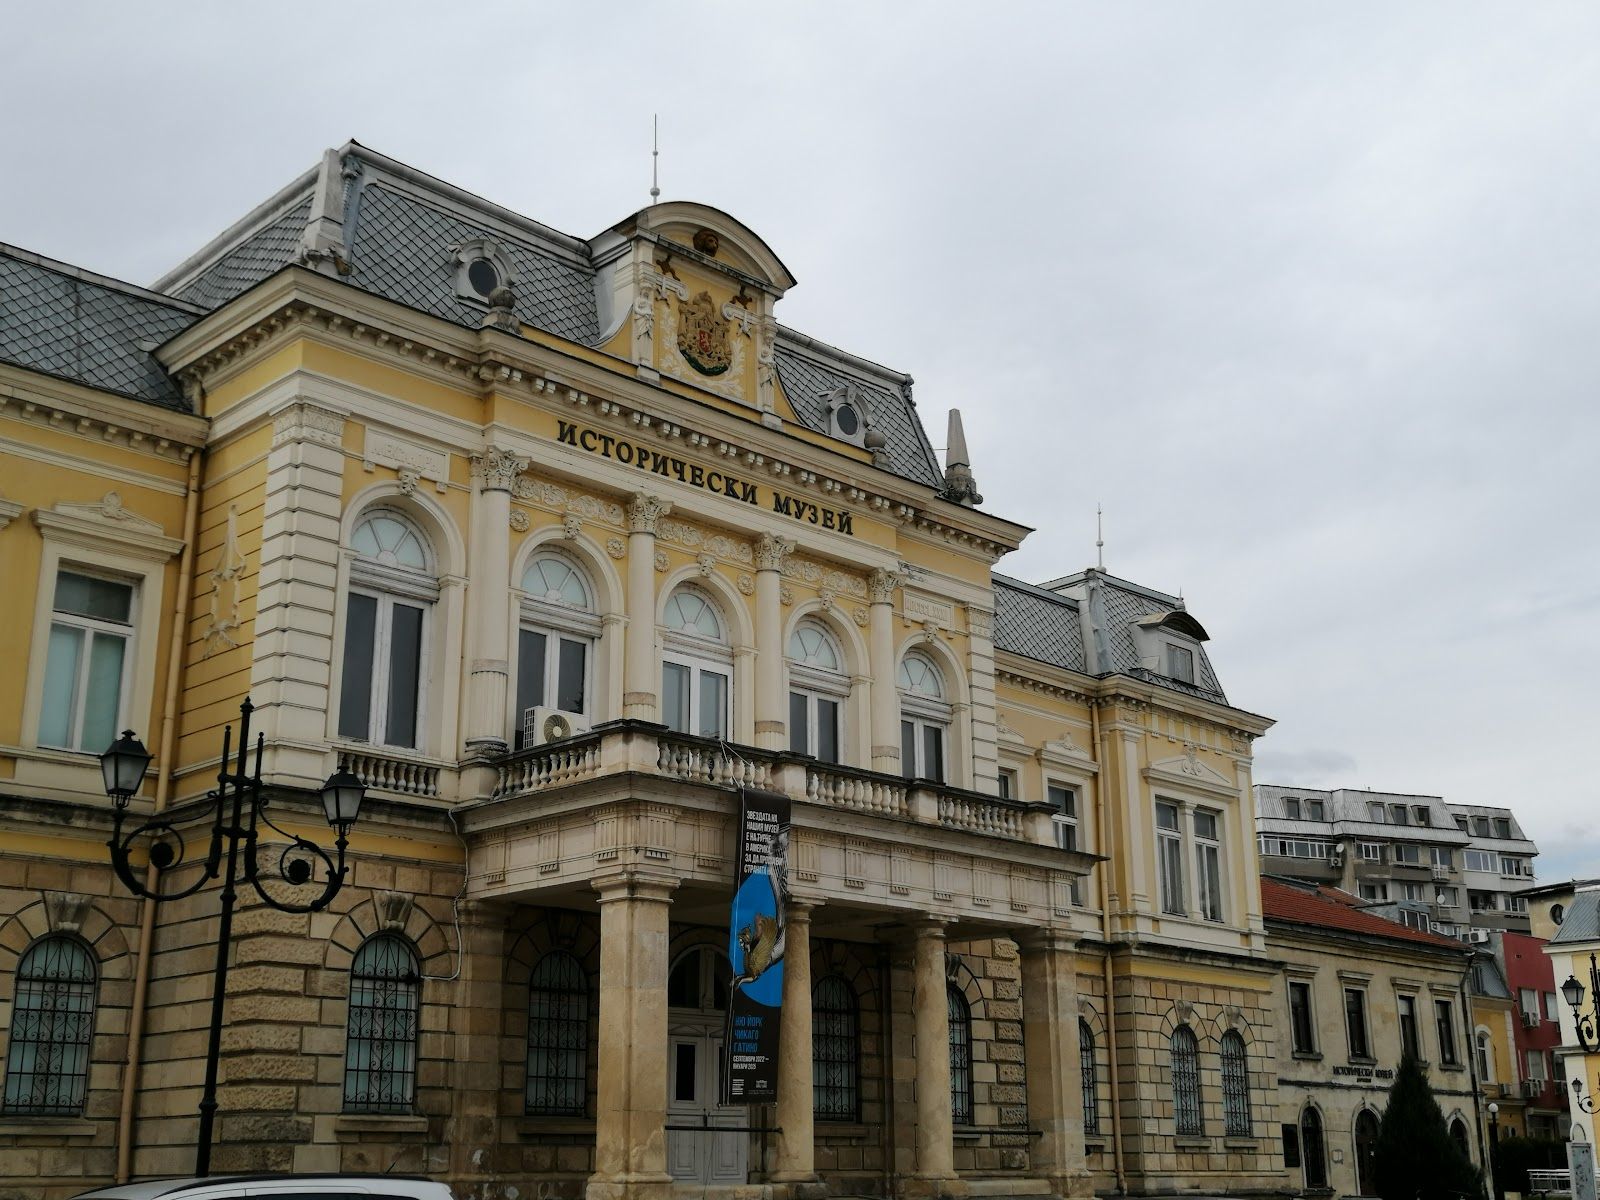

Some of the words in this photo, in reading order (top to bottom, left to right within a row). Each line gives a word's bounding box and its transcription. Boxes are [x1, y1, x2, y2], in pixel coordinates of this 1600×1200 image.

[557, 420, 758, 505] ИСТОРИЧЕСКИ
[773, 491, 854, 536] МУЗЕЙ
[747, 811, 770, 822] ЗВЕЗДАТА
[771, 813, 778, 823] НА
[747, 821, 763, 832] НАШИЯ
[764, 823, 779, 834] МУЗЕЙ
[746, 832, 750, 841] Е
[750, 832, 757, 842] НА
[757, 833, 772, 843] ТУРНЕ
[745, 843, 749, 851] В
[745, 853, 752, 862] ЗА
[752, 854, 759, 864] ДА
[747, 1014, 762, 1027] ЙОРК
[735, 1030, 759, 1040] ЧИКАГО
[734, 1042, 758, 1053] ГАТИНО
